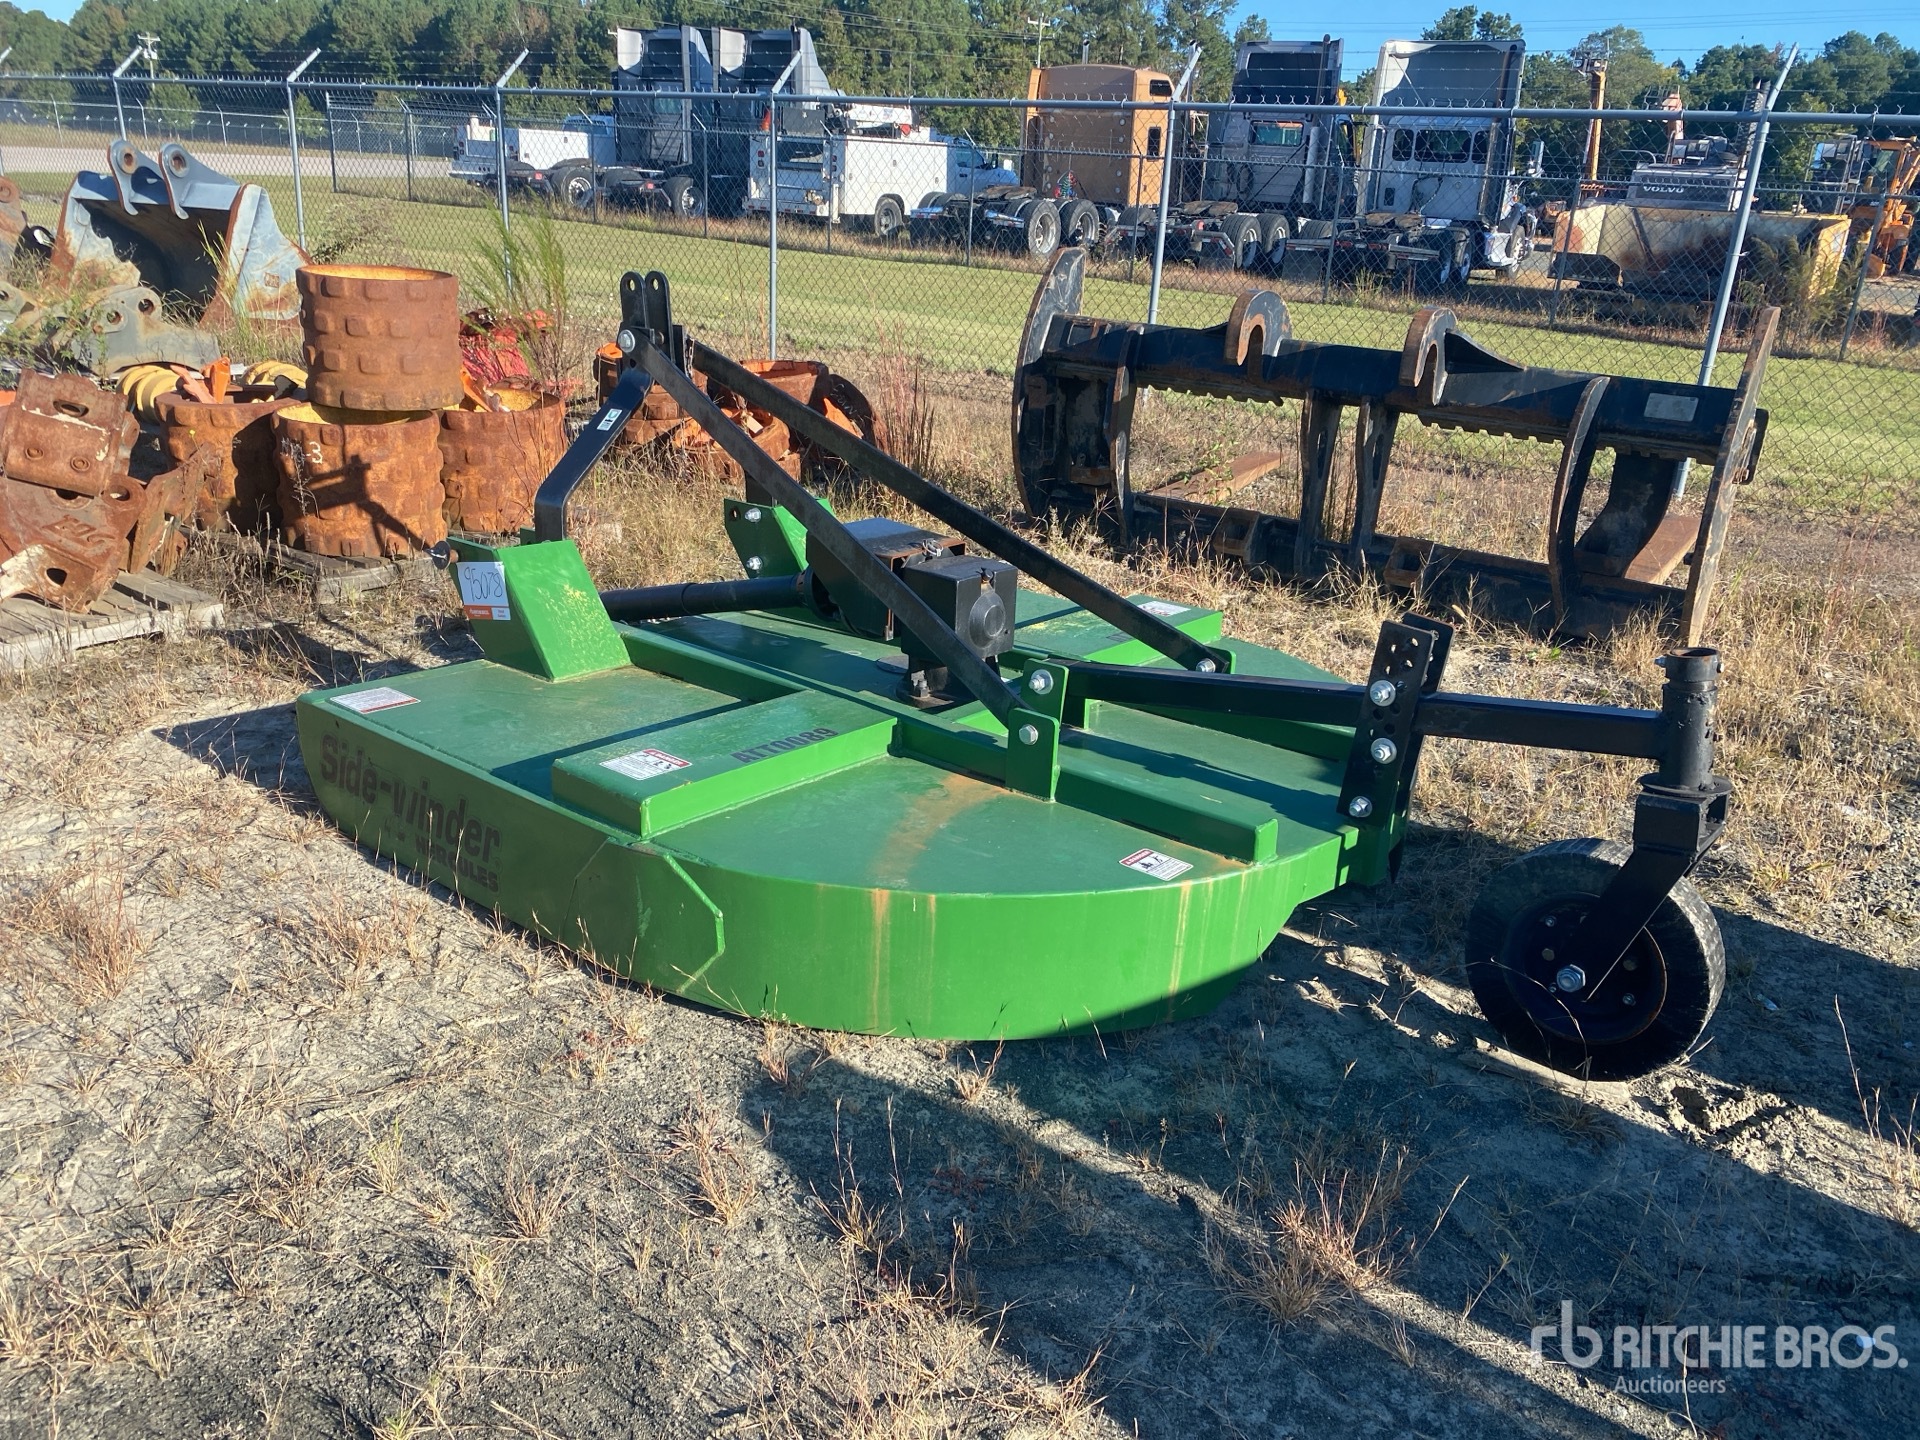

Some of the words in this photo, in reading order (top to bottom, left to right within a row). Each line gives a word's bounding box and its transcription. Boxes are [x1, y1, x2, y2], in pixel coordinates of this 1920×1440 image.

[1643, 185, 1685, 194] VOLVO
[463, 566, 503, 602] 95078
[730, 727, 839, 763] ATT0089
[320, 734, 500, 863] Side-winder
